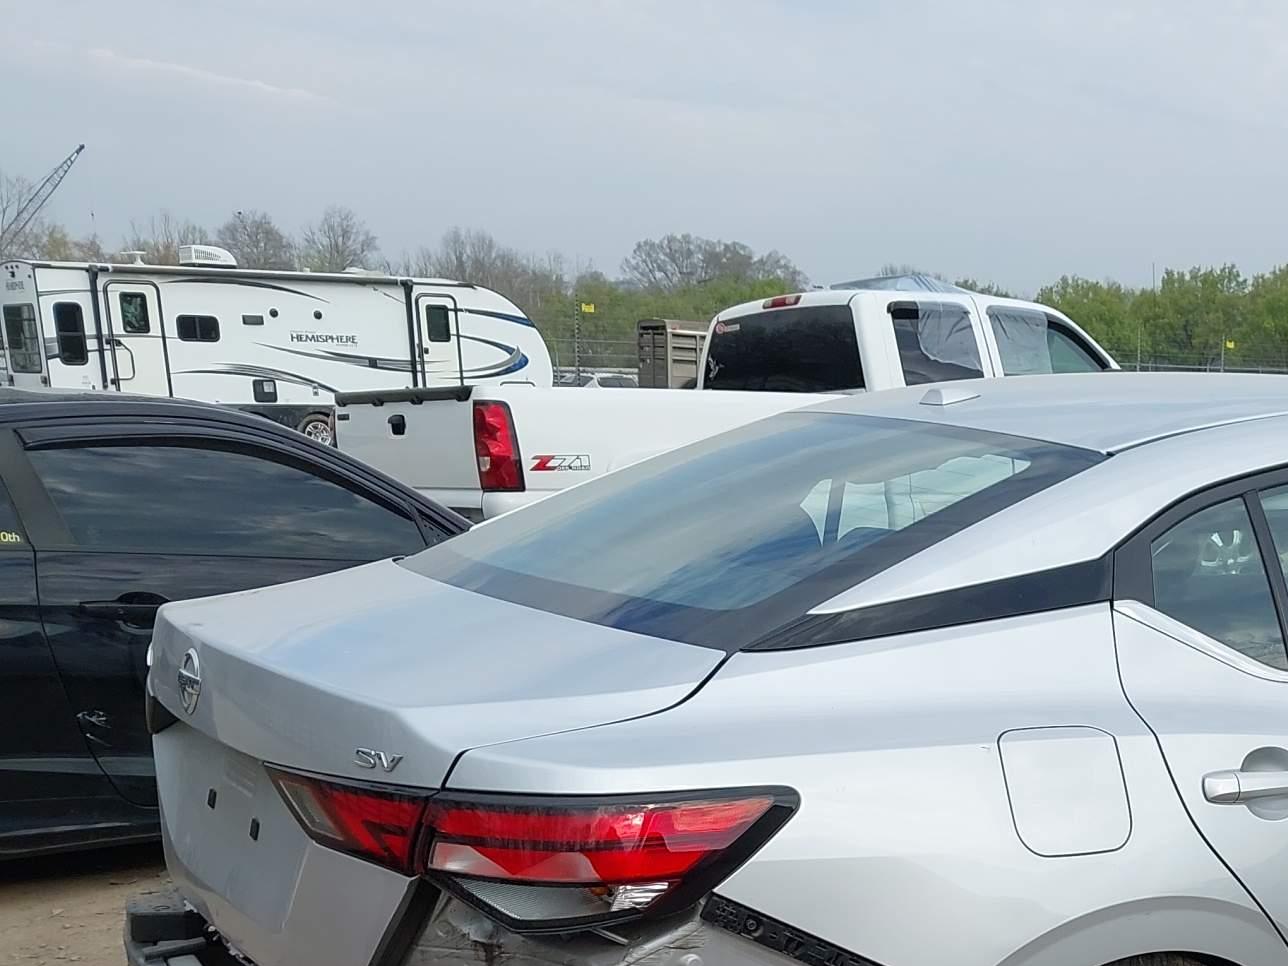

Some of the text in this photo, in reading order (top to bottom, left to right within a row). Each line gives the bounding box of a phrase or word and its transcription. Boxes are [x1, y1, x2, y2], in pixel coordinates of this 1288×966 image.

[290, 334, 358, 344] HEMISPHERE
[529, 455, 590, 471] Z71
[354, 747, 404, 772] SV
